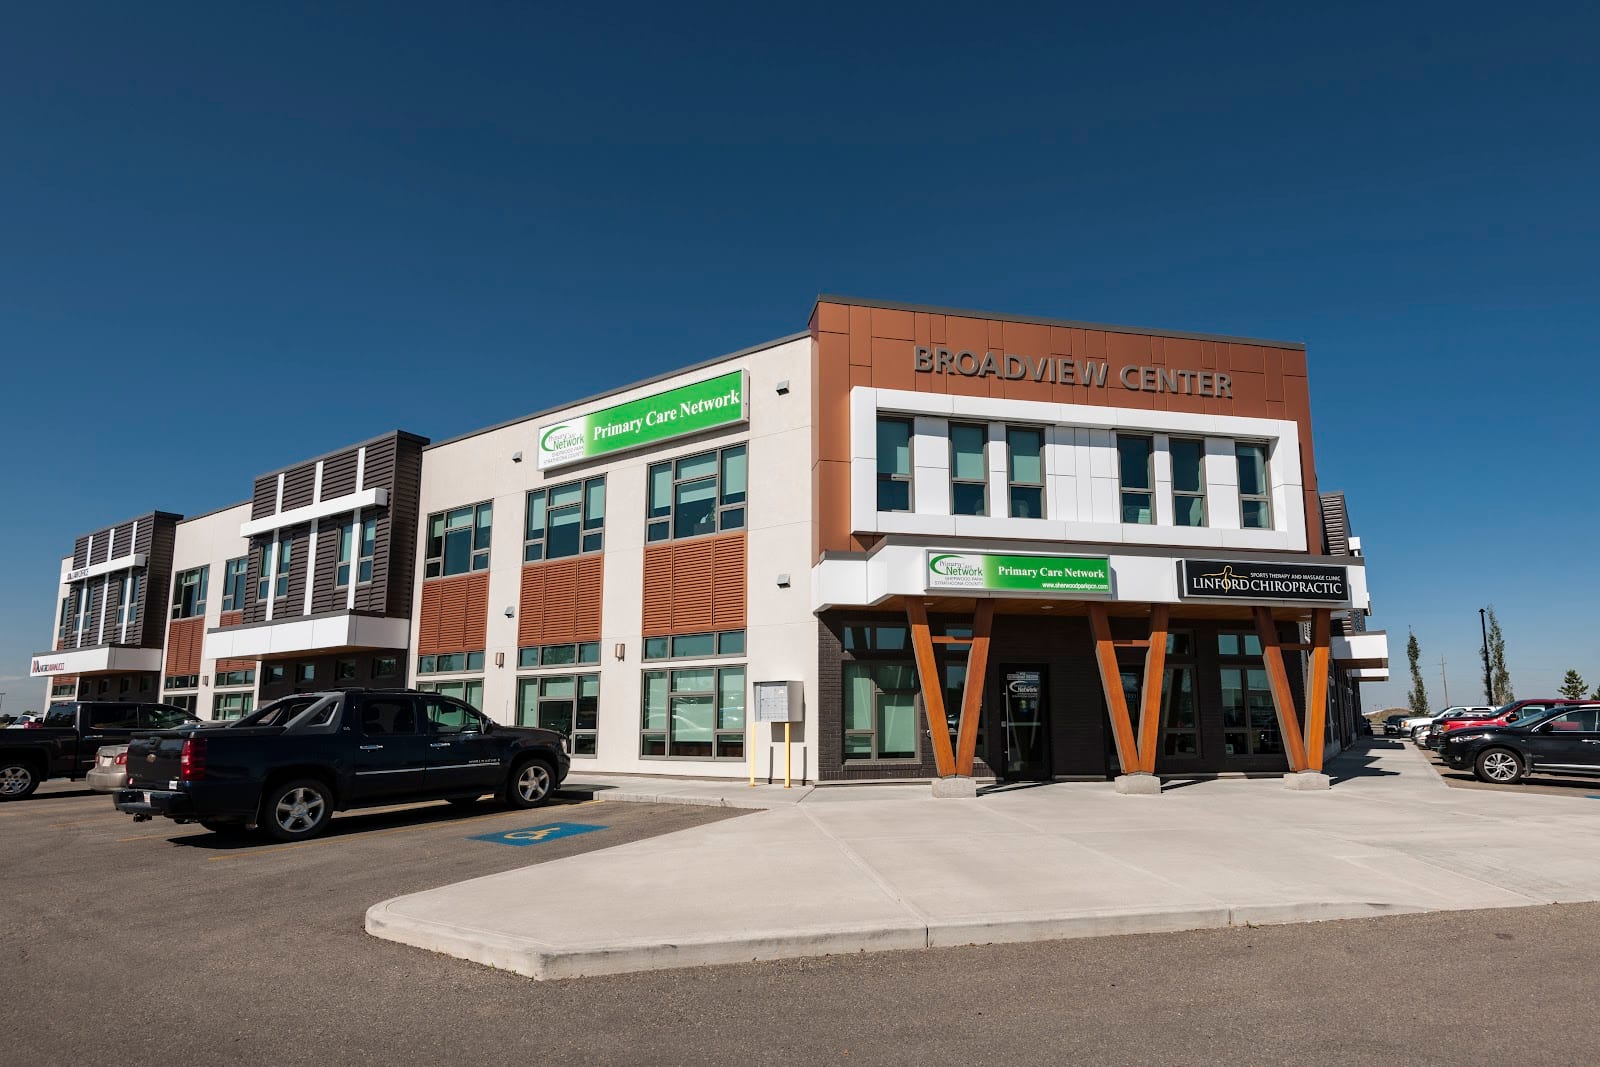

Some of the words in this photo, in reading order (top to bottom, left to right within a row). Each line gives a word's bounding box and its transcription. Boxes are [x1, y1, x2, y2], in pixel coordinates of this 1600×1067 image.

[914, 345, 1108, 387] BROADVIEW
[1120, 364, 1233, 398] CENTER
[593, 417, 643, 441] Primary
[645, 408, 677, 426] Care
[680, 389, 740, 417] Network
[553, 433, 585, 450] Network
[946, 566, 984, 576] Network
[998, 566, 1038, 579] Primary
[1040, 567, 1063, 577] Care
[1064, 568, 1105, 579] Network
[1041, 582, 1109, 590] www.sherwoodparkpcn.com
[1193, 577, 1250, 591] LINFORD
[1250, 580, 1343, 594] CHIROPRACTIC
